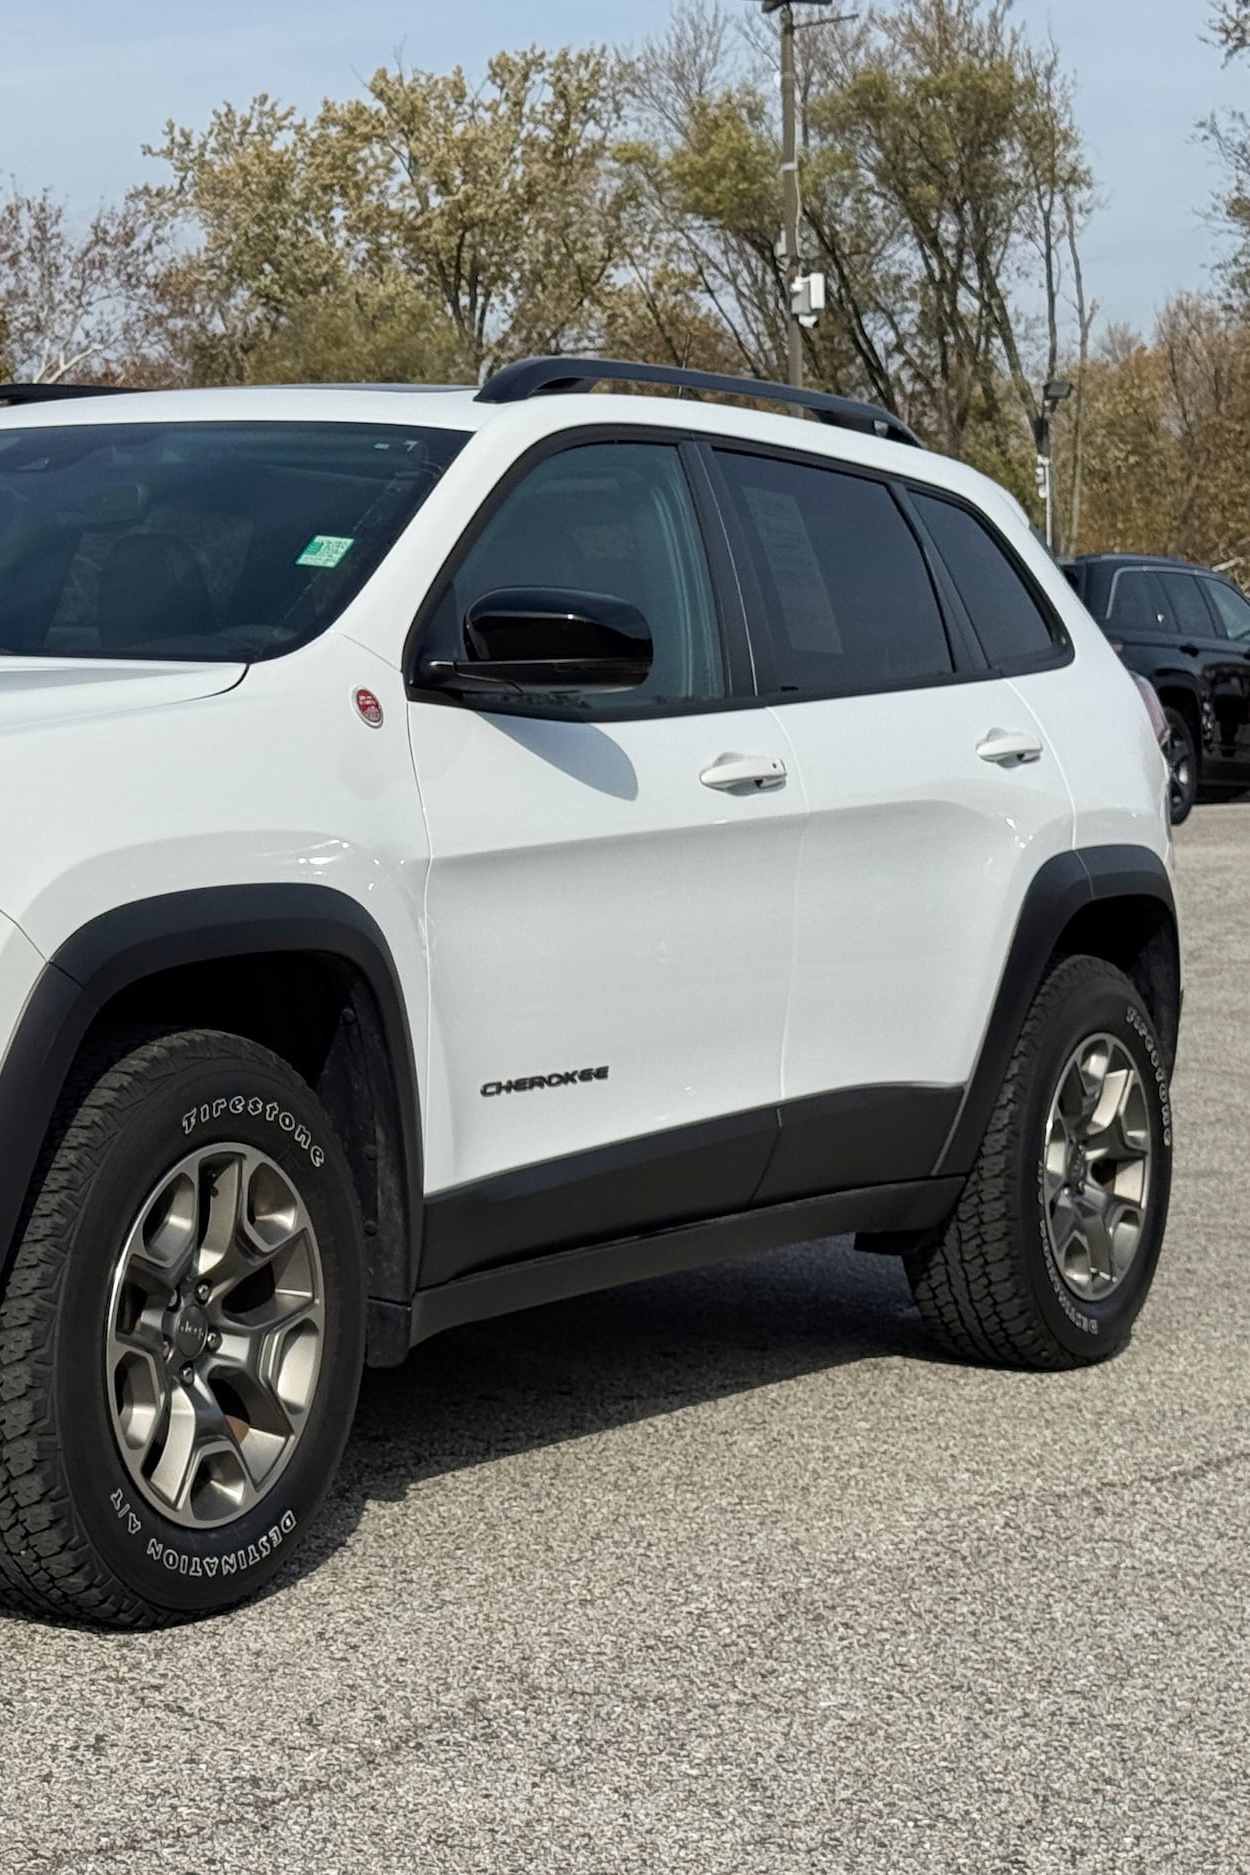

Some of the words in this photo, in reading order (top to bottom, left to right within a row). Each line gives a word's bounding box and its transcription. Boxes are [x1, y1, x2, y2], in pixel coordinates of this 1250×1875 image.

[480, 1066, 610, 1098] CHEROKEE
[182, 1096, 325, 1167] Firestone
[110, 1488, 142, 1534] A/T
[147, 1510, 298, 1577] DESTINATION
